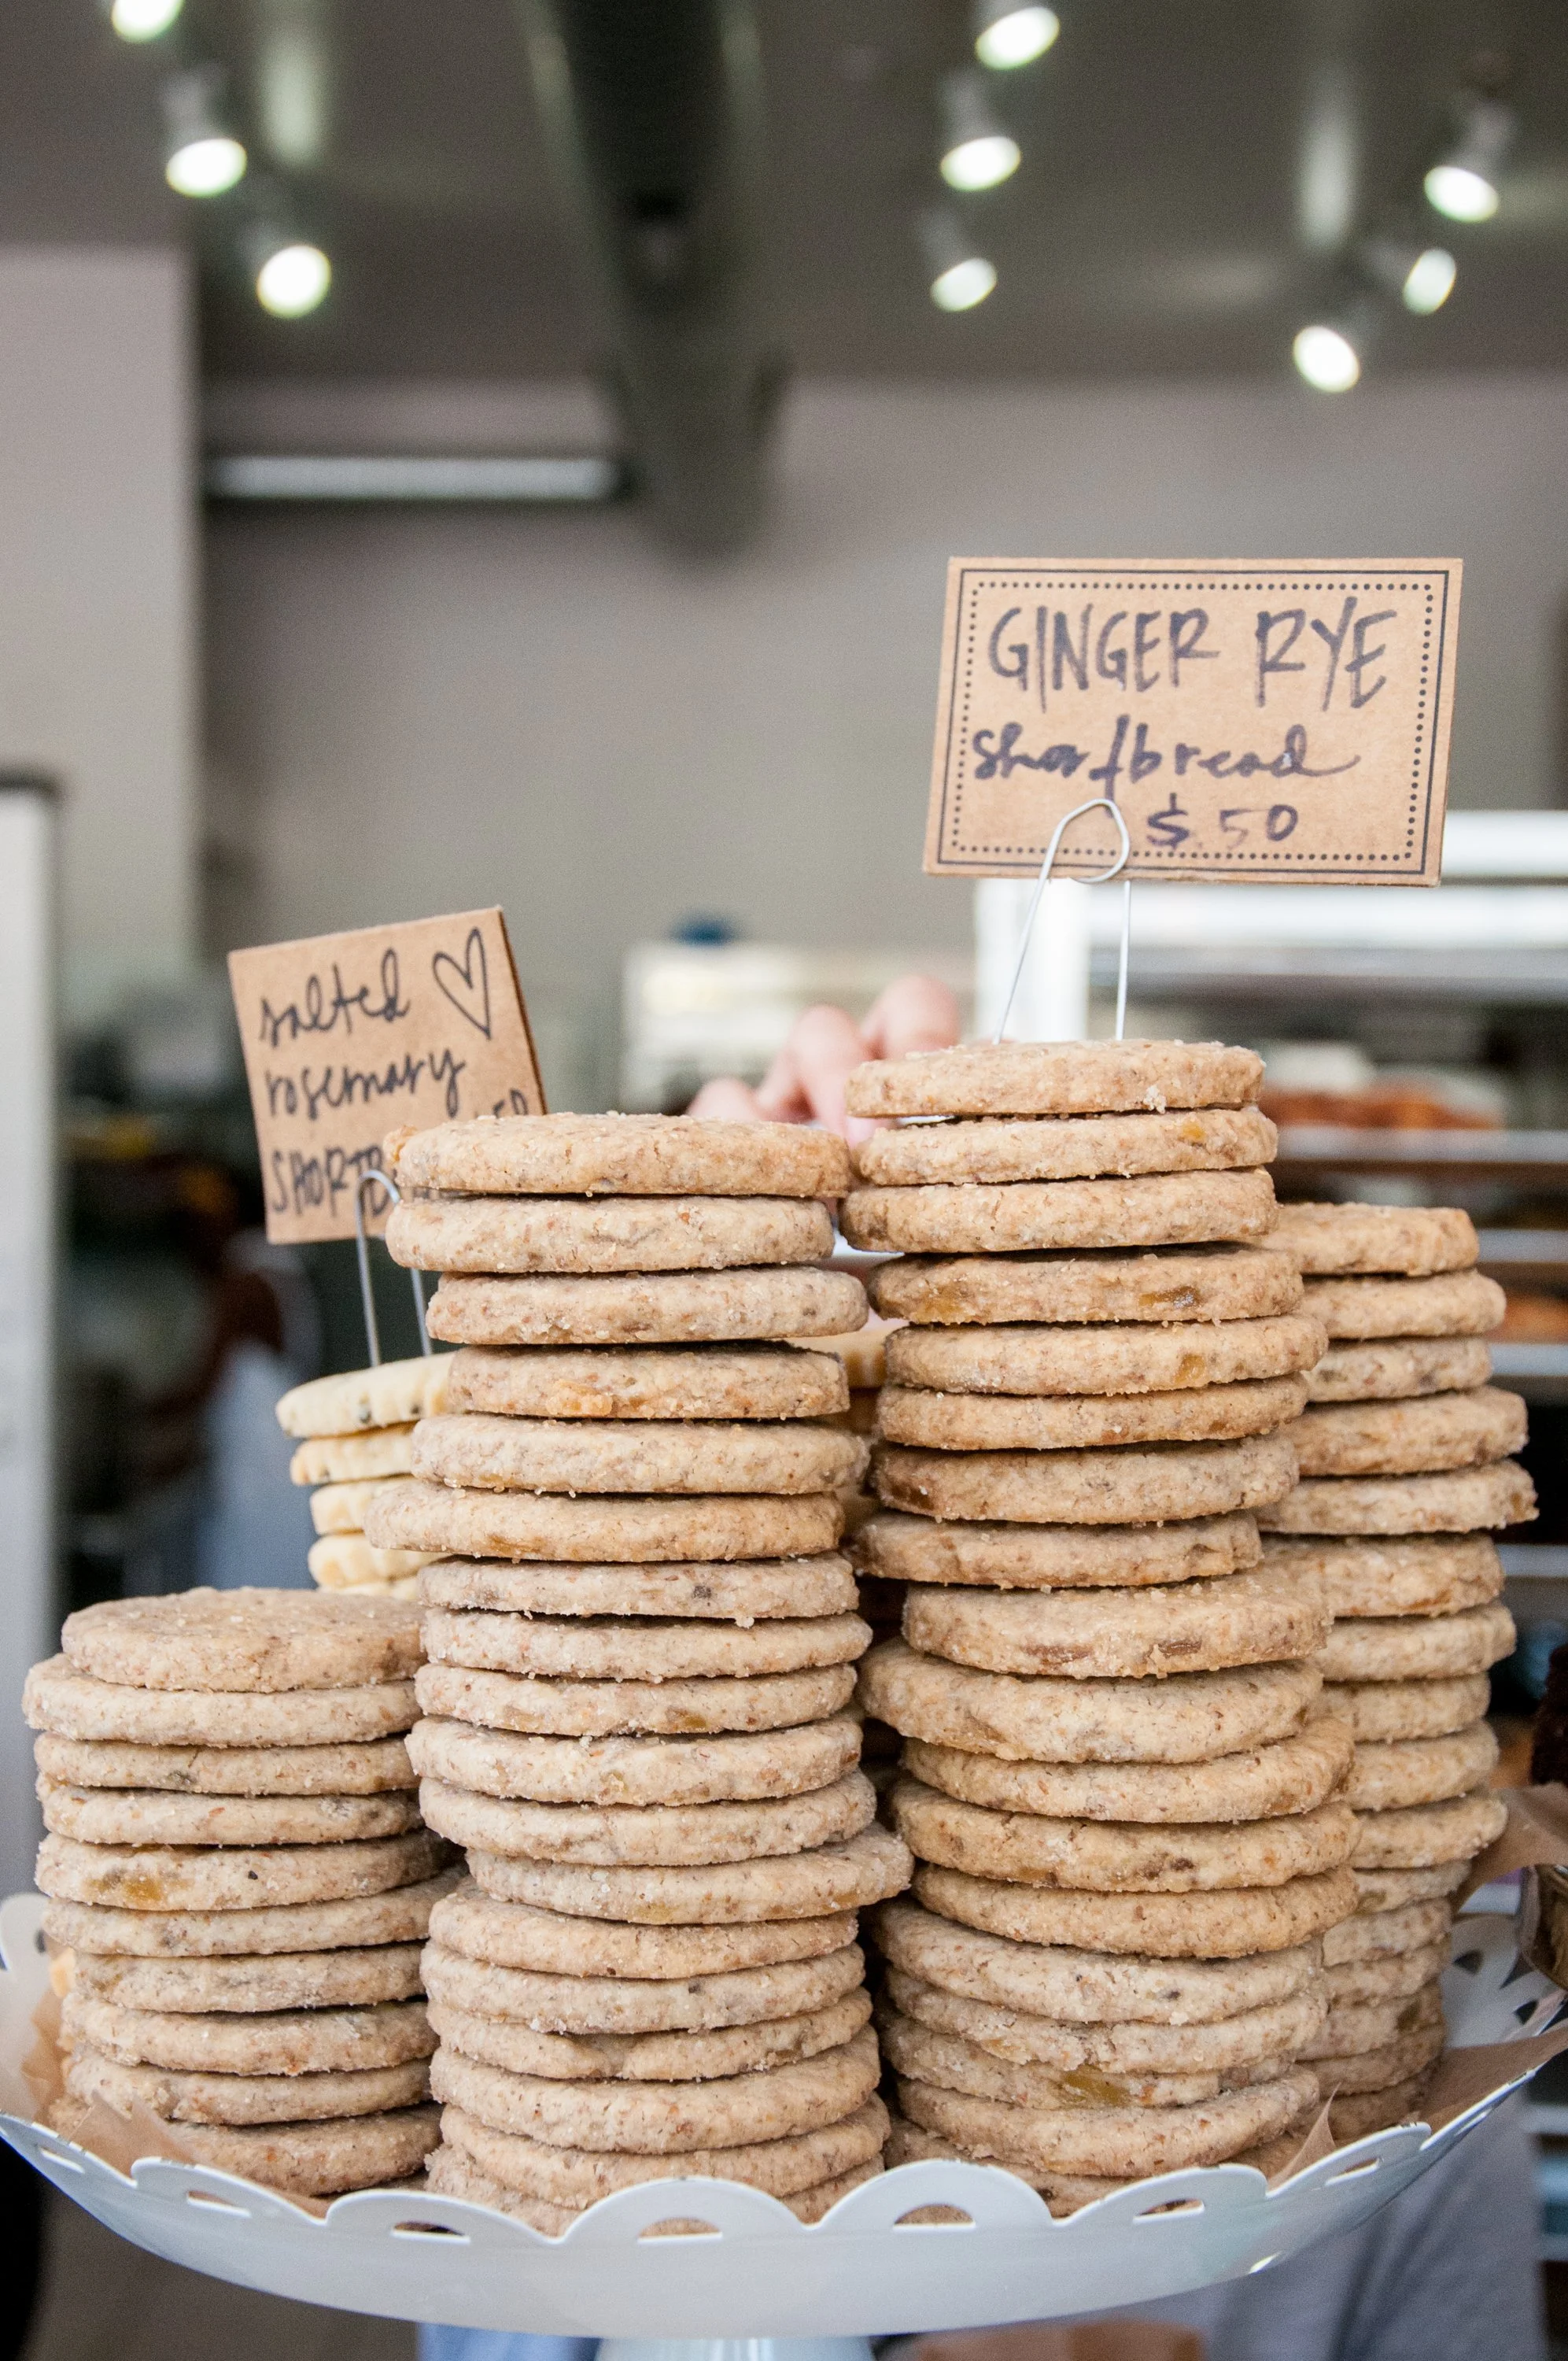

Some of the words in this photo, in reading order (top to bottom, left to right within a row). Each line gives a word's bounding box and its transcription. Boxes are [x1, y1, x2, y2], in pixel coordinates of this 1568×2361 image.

[988, 603, 1219, 713] GINGER
[1255, 597, 1398, 712] RYE
[260, 948, 411, 1048] salted
[266, 1047, 467, 1121] rosemary
[271, 1145, 400, 1218] SHORTB
